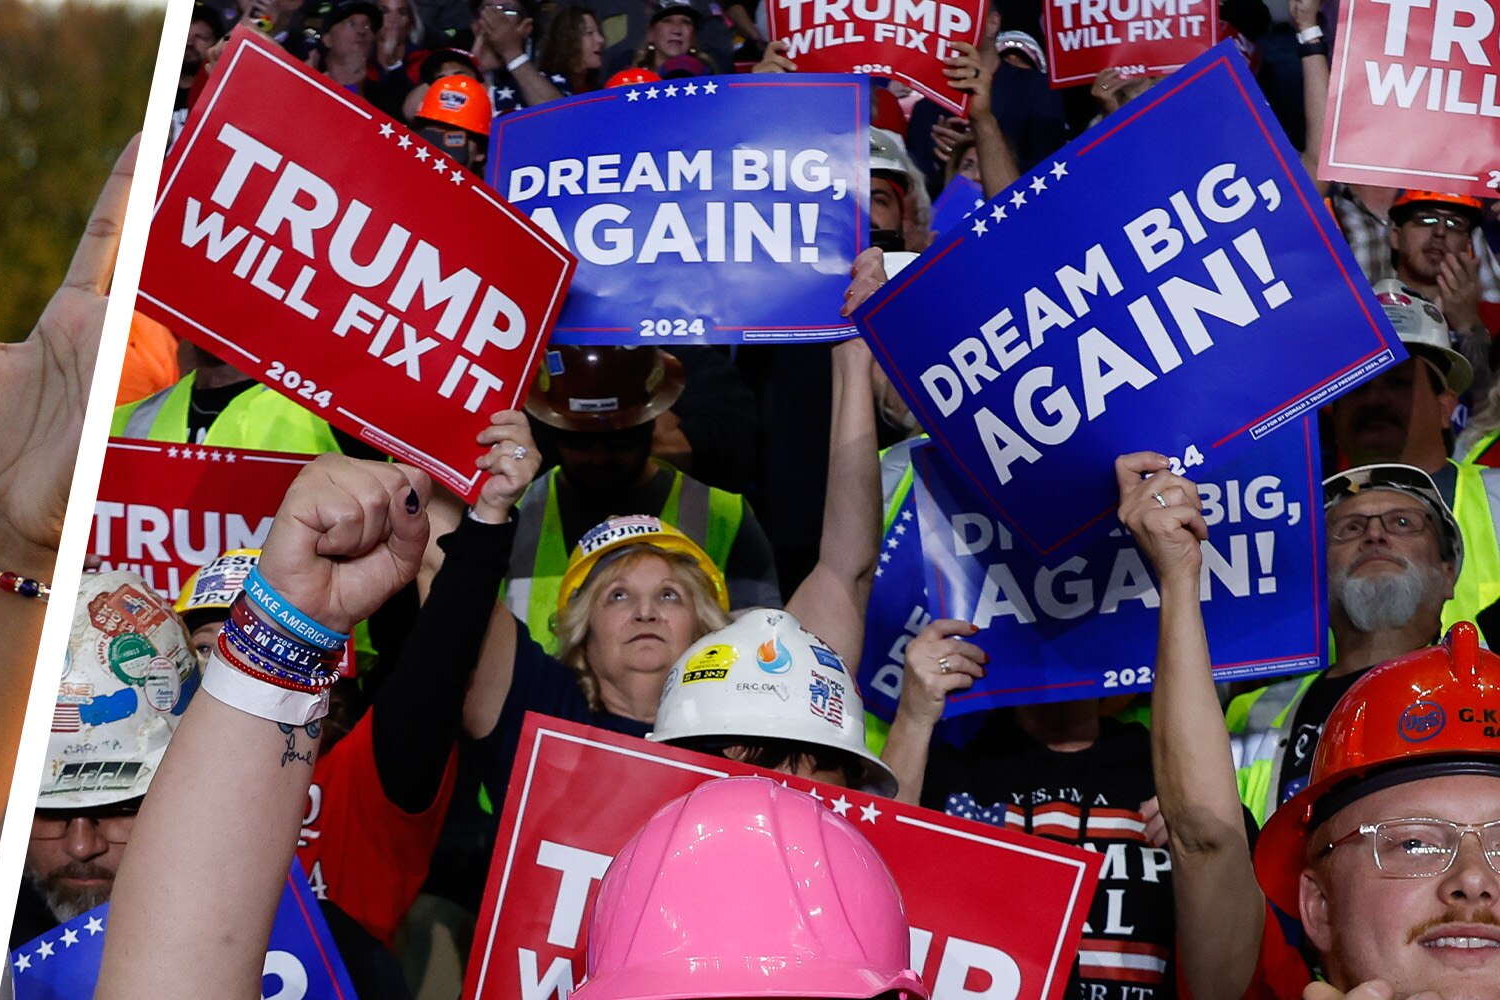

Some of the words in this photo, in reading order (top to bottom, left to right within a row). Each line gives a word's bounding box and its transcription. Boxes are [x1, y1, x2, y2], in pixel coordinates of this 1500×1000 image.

[778, 0, 972, 38] TRUMP
[1054, 0, 1204, 28] TRUMP
[1057, 24, 1122, 52] WILL
[1128, 18, 1173, 42] FIX
[1179, 15, 1206, 37] IT
[1370, 0, 1500, 66] TR
[781, 22, 865, 59] WILL
[874, 23, 929, 53] FIX
[853, 64, 892, 74] 2024
[1365, 60, 1500, 117] WILL
[508, 150, 713, 204] DREAM
[732, 149, 847, 200] BIG,
[210, 123, 526, 357] TRUMP
[530, 202, 820, 266] AGAIN!
[180, 197, 320, 320] WILL
[332, 293, 441, 382] FIX
[438, 355, 504, 414] IT
[919, 243, 1125, 418] DREAM
[1123, 163, 1282, 274] BIG,
[639, 318, 706, 338] 2024
[973, 228, 1294, 486] AGAIN!
[266, 361, 332, 408] 2024
[1146, 444, 1205, 478] 24
[1199, 475, 1302, 527] BIG,
[91, 500, 274, 567] TRUM
[972, 530, 1278, 630] AGAN!
[250, 581, 281, 614] TAKE
[278, 610, 330, 648] AMERICA
[243, 623, 310, 666] TRUMP
[1103, 666, 1156, 688] 202
[1403, 710, 1442, 733] USS
[1094, 793, 1109, 805] A
